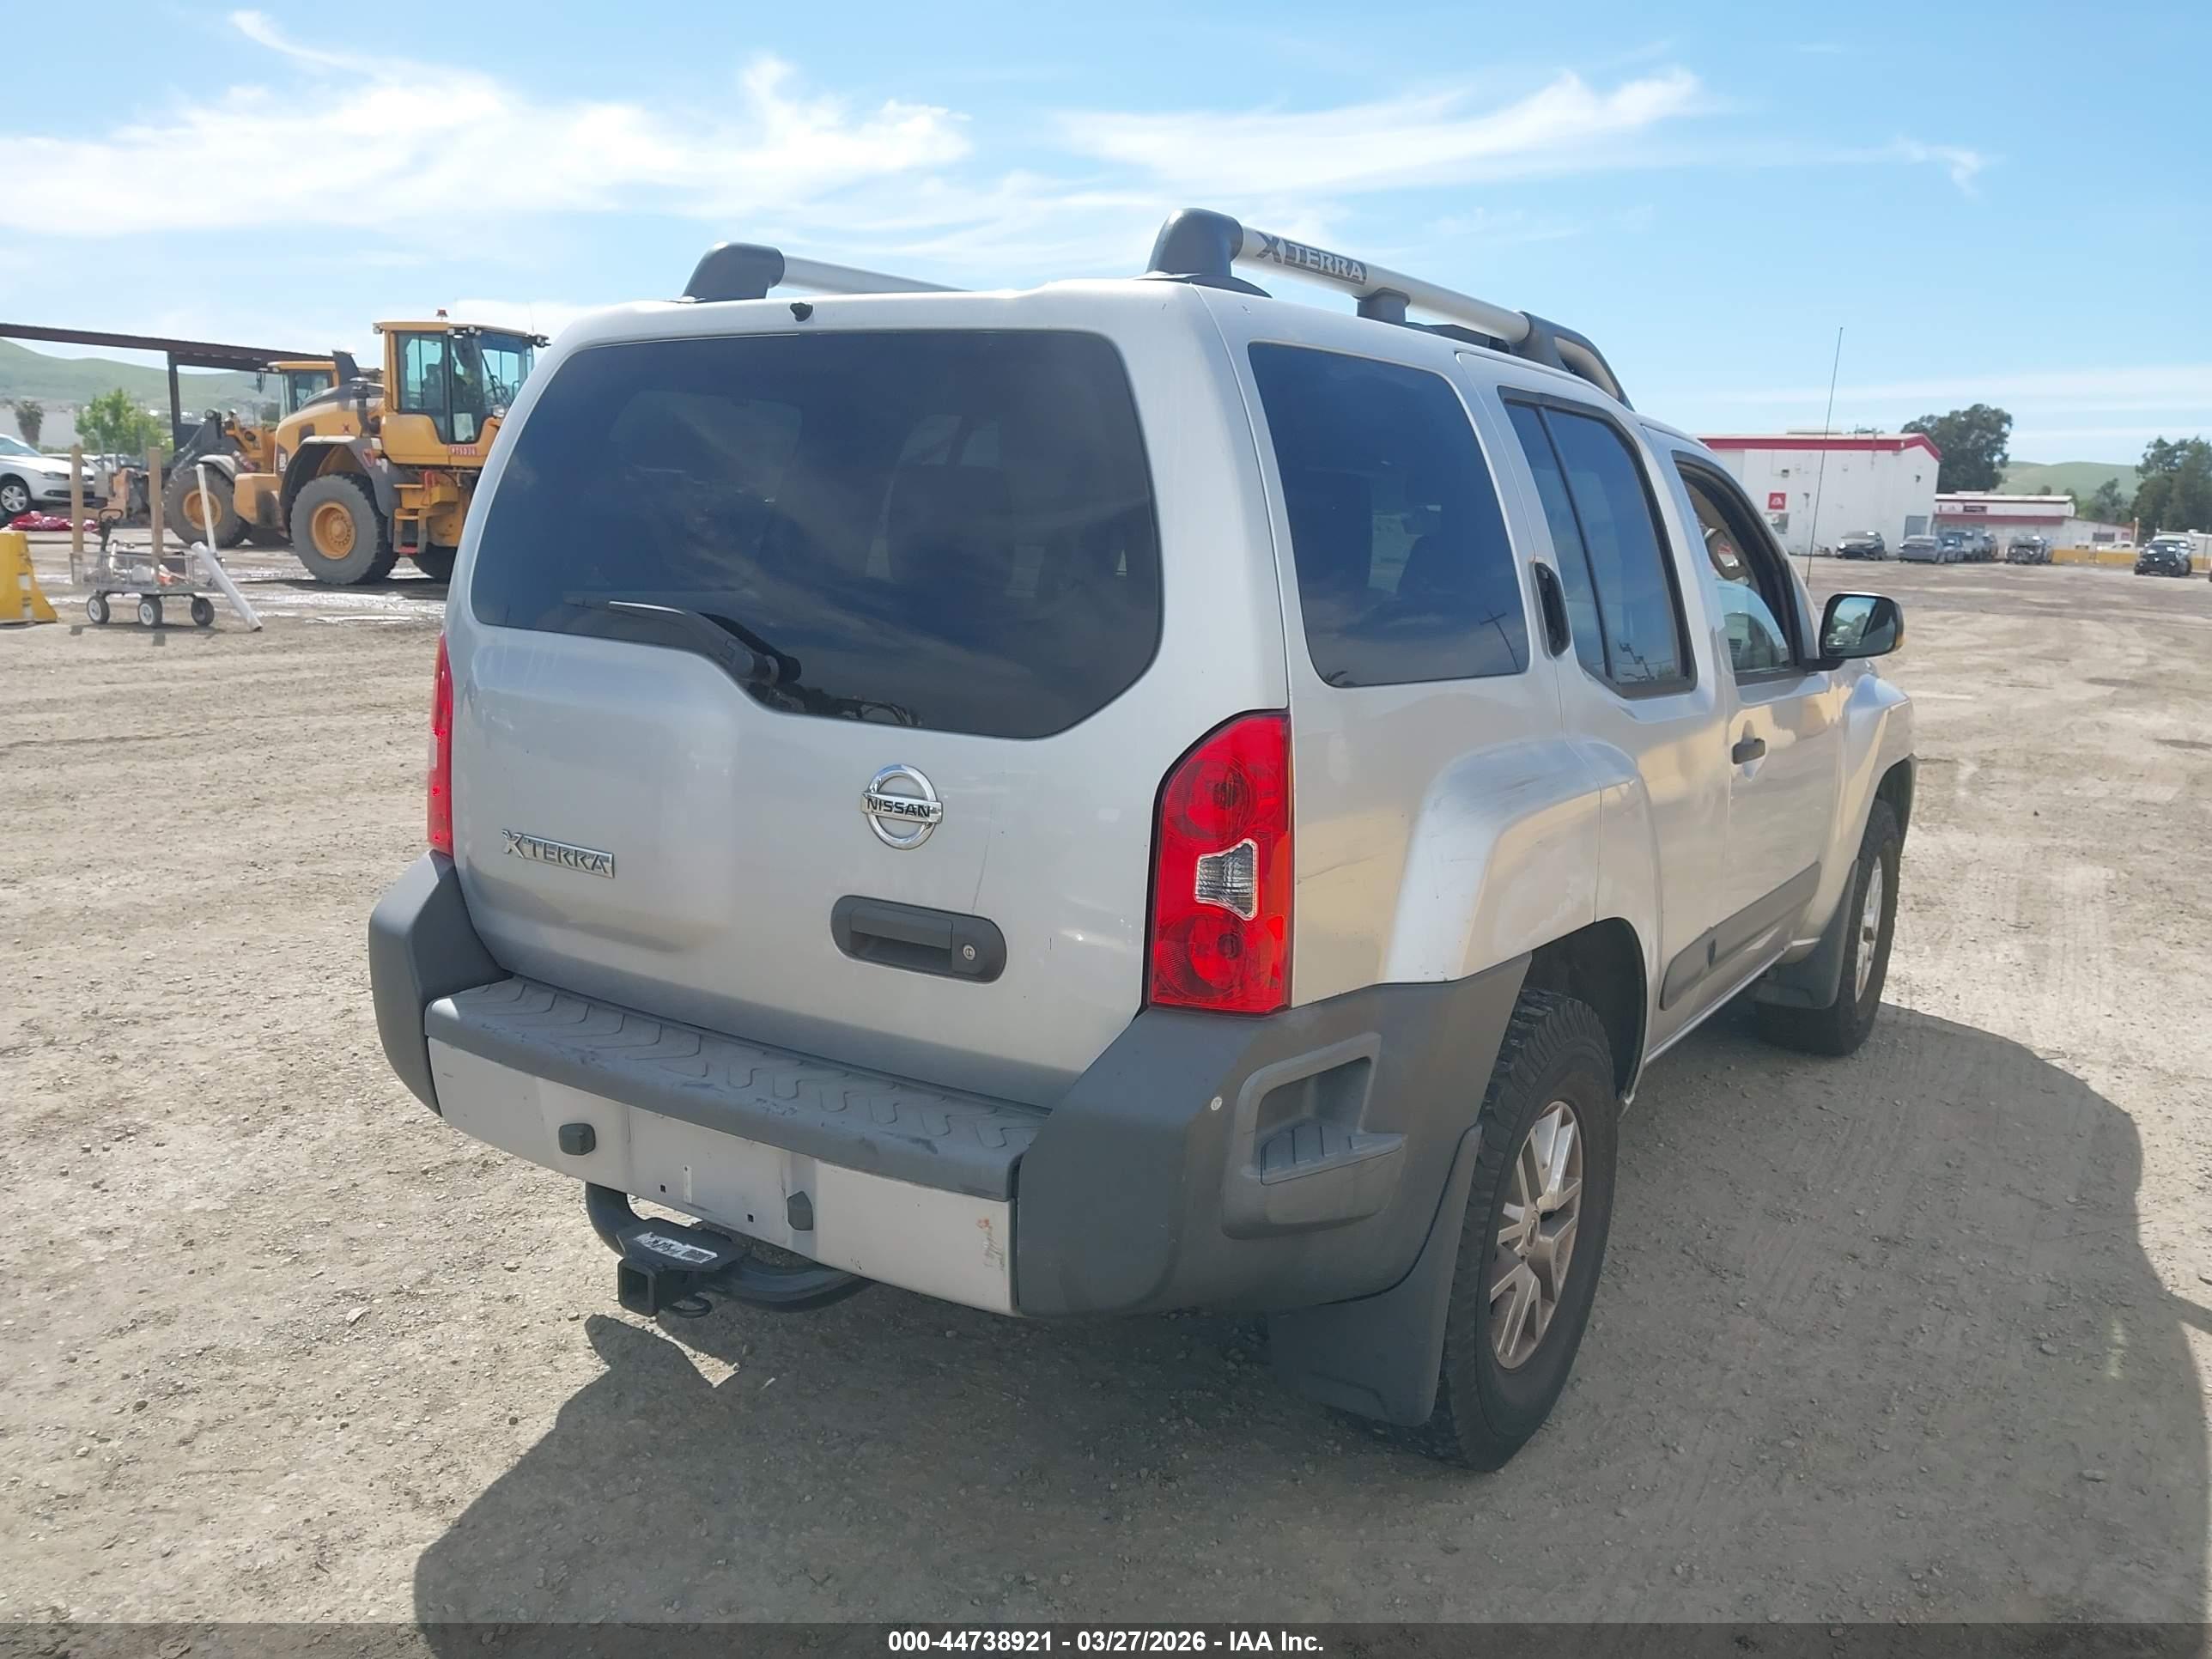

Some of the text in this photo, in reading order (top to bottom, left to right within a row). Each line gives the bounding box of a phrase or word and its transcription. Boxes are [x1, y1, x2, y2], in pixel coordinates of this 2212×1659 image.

[1255, 230, 1366, 284] XTERRA
[867, 798, 930, 818] NISSAN
[501, 829, 612, 876] XTERRA
